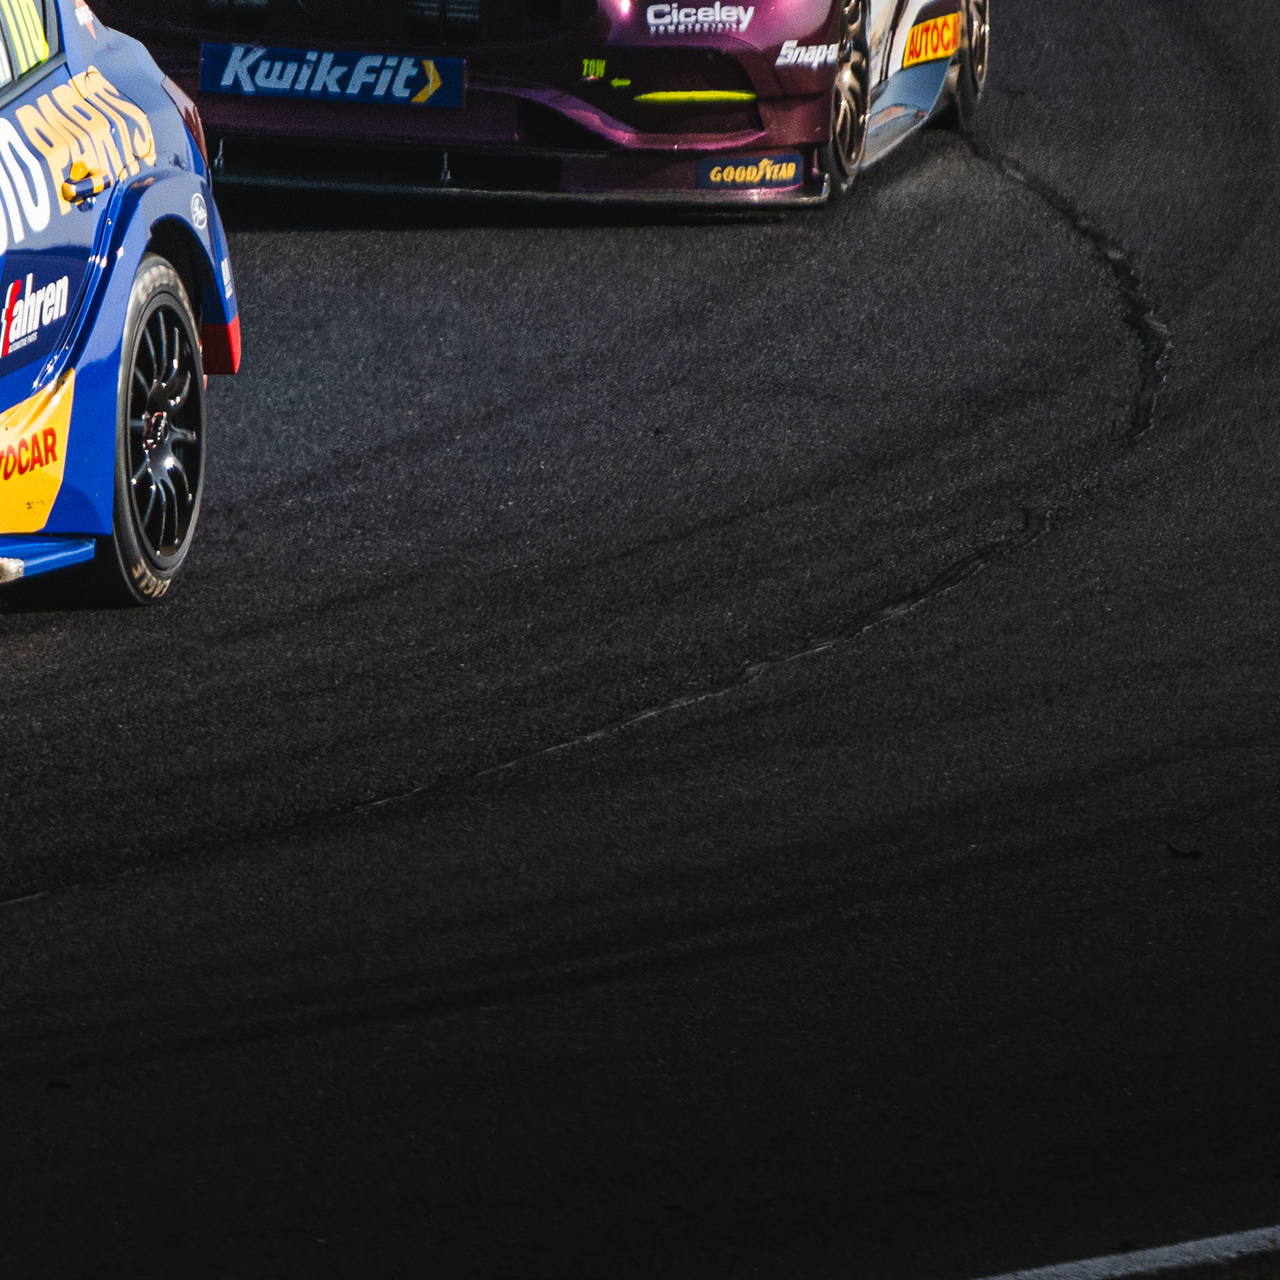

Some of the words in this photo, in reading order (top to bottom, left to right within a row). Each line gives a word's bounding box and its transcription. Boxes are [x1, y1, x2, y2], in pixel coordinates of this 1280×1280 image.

[646, 1, 755, 33] Ciceley
[907, 14, 961, 62] AUTOC
[582, 59, 607, 79] TOW
[775, 39, 841, 72] Snap-o
[14, 65, 158, 215] PARTS
[709, 158, 796, 183] GOODYEAR
